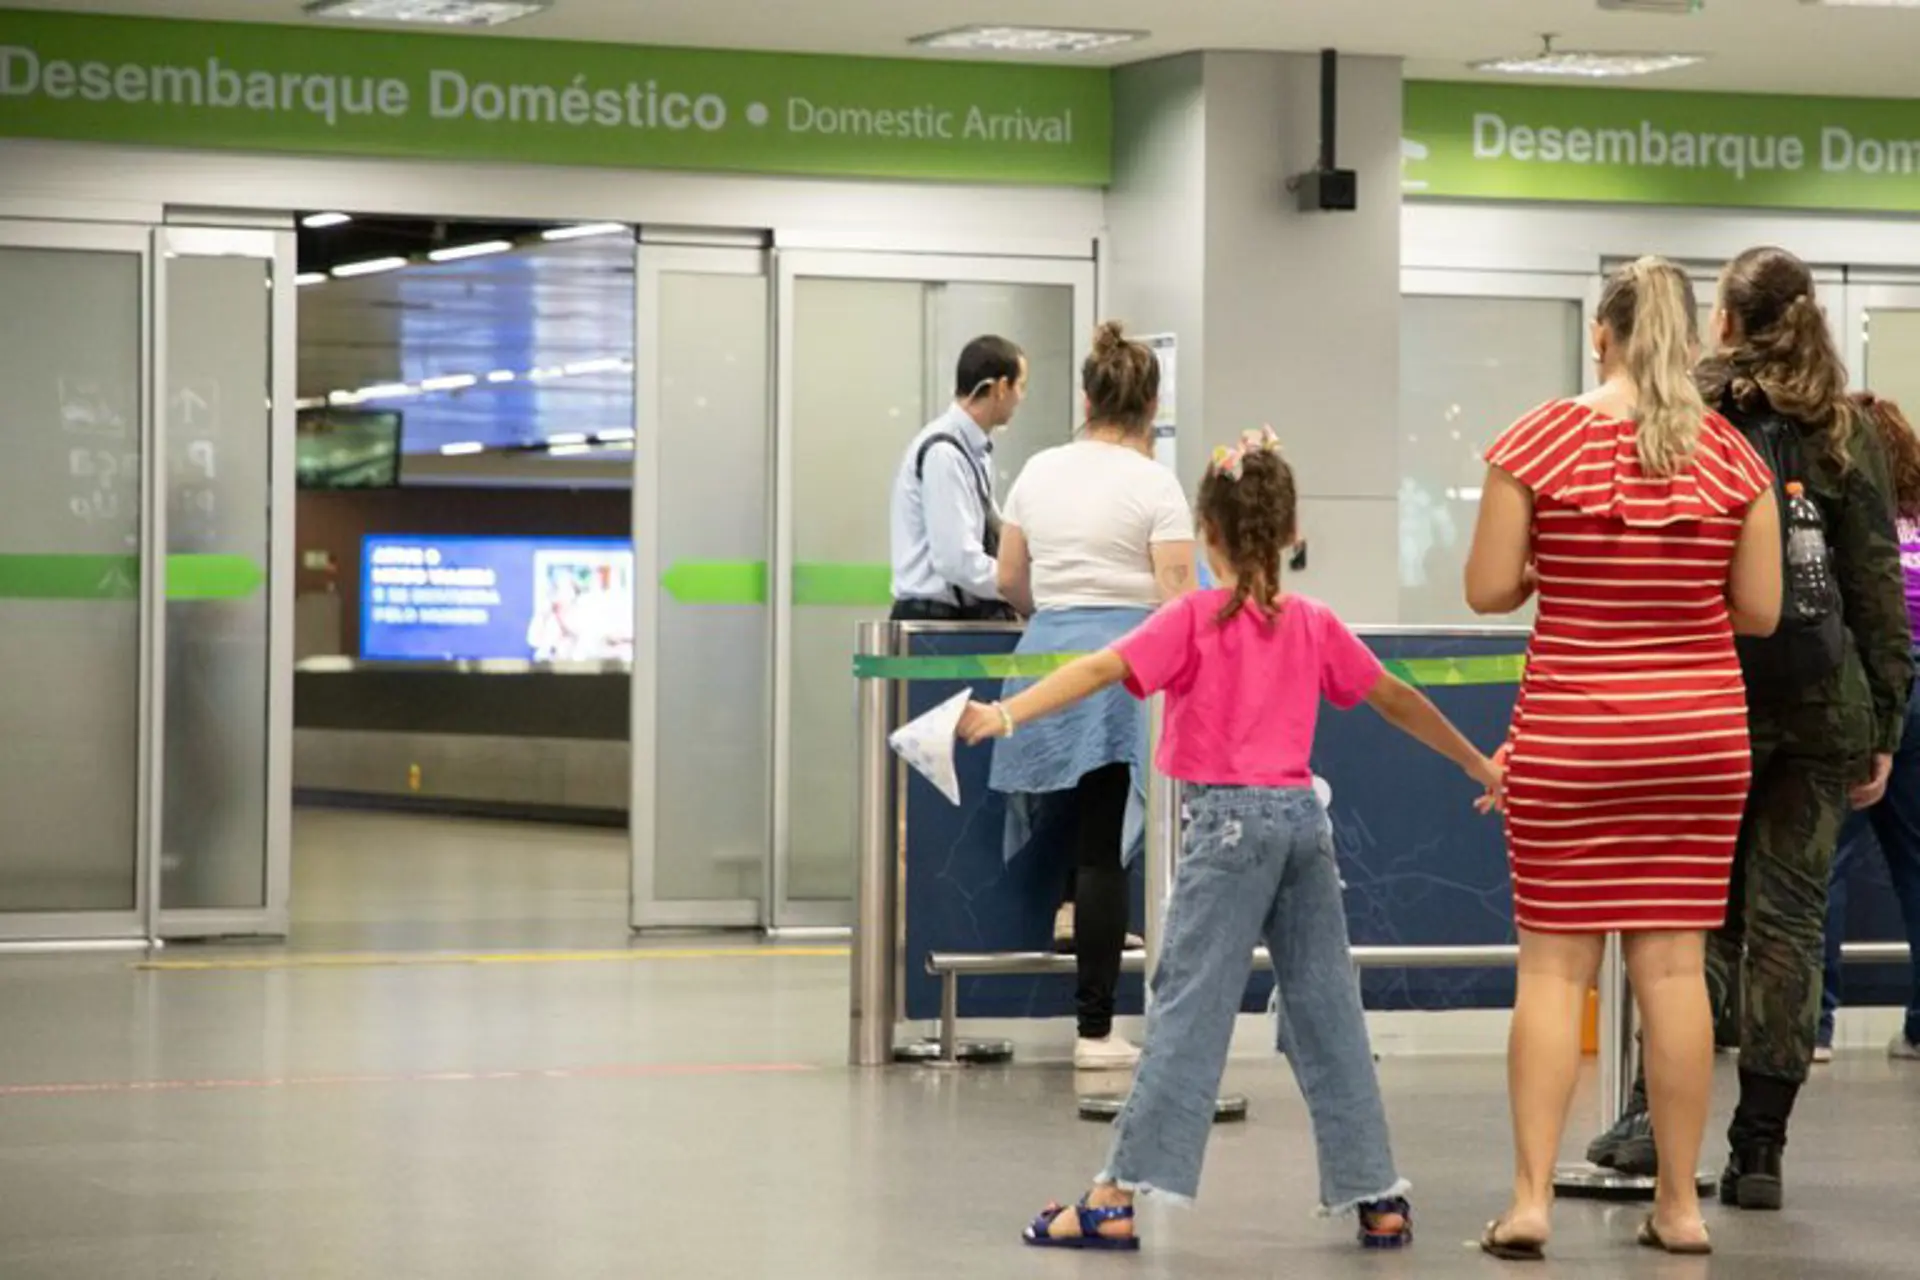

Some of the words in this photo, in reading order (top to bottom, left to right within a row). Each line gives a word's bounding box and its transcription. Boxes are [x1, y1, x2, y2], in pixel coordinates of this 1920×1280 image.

[0, 45, 410, 126] Desembarque
[429, 69, 727, 131] Doméstico
[787, 97, 954, 139] Domestic
[963, 105, 1073, 144] Arrival
[1472, 113, 1804, 180] Desembarque
